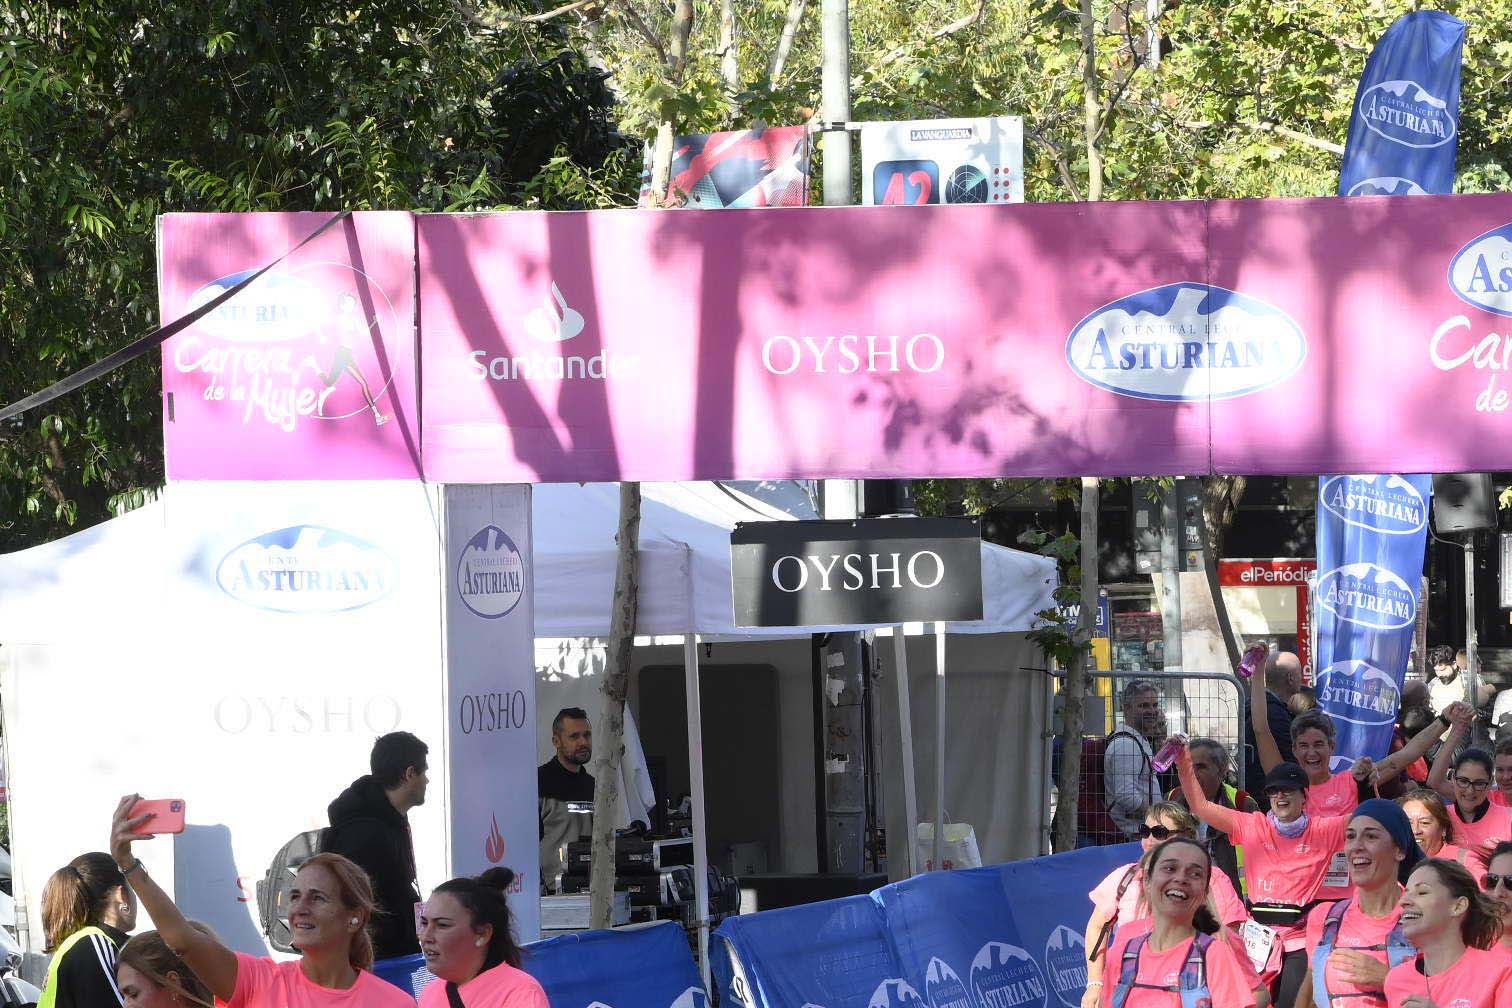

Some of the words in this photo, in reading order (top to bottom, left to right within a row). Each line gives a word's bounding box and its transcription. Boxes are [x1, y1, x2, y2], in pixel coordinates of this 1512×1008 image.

[1366, 94, 1446, 138] ASTURIANA
[174, 335, 296, 373] Carrera
[468, 348, 638, 381] Santander
[761, 332, 946, 376] OYSHO
[204, 377, 225, 401] de
[243, 370, 336, 432] Mujer
[1475, 380, 1510, 412] de
[1331, 482, 1420, 526] ASTURIANA
[462, 565, 521, 596] ASTURIANA
[771, 549, 946, 594] OYSHO
[1324, 579, 1410, 620] ASTURIANA
[213, 694, 403, 735] OYSHO
[460, 690, 527, 735] OYSHO
[1256, 878, 1273, 892] TU
[1050, 960, 1089, 993] ASTURIA
